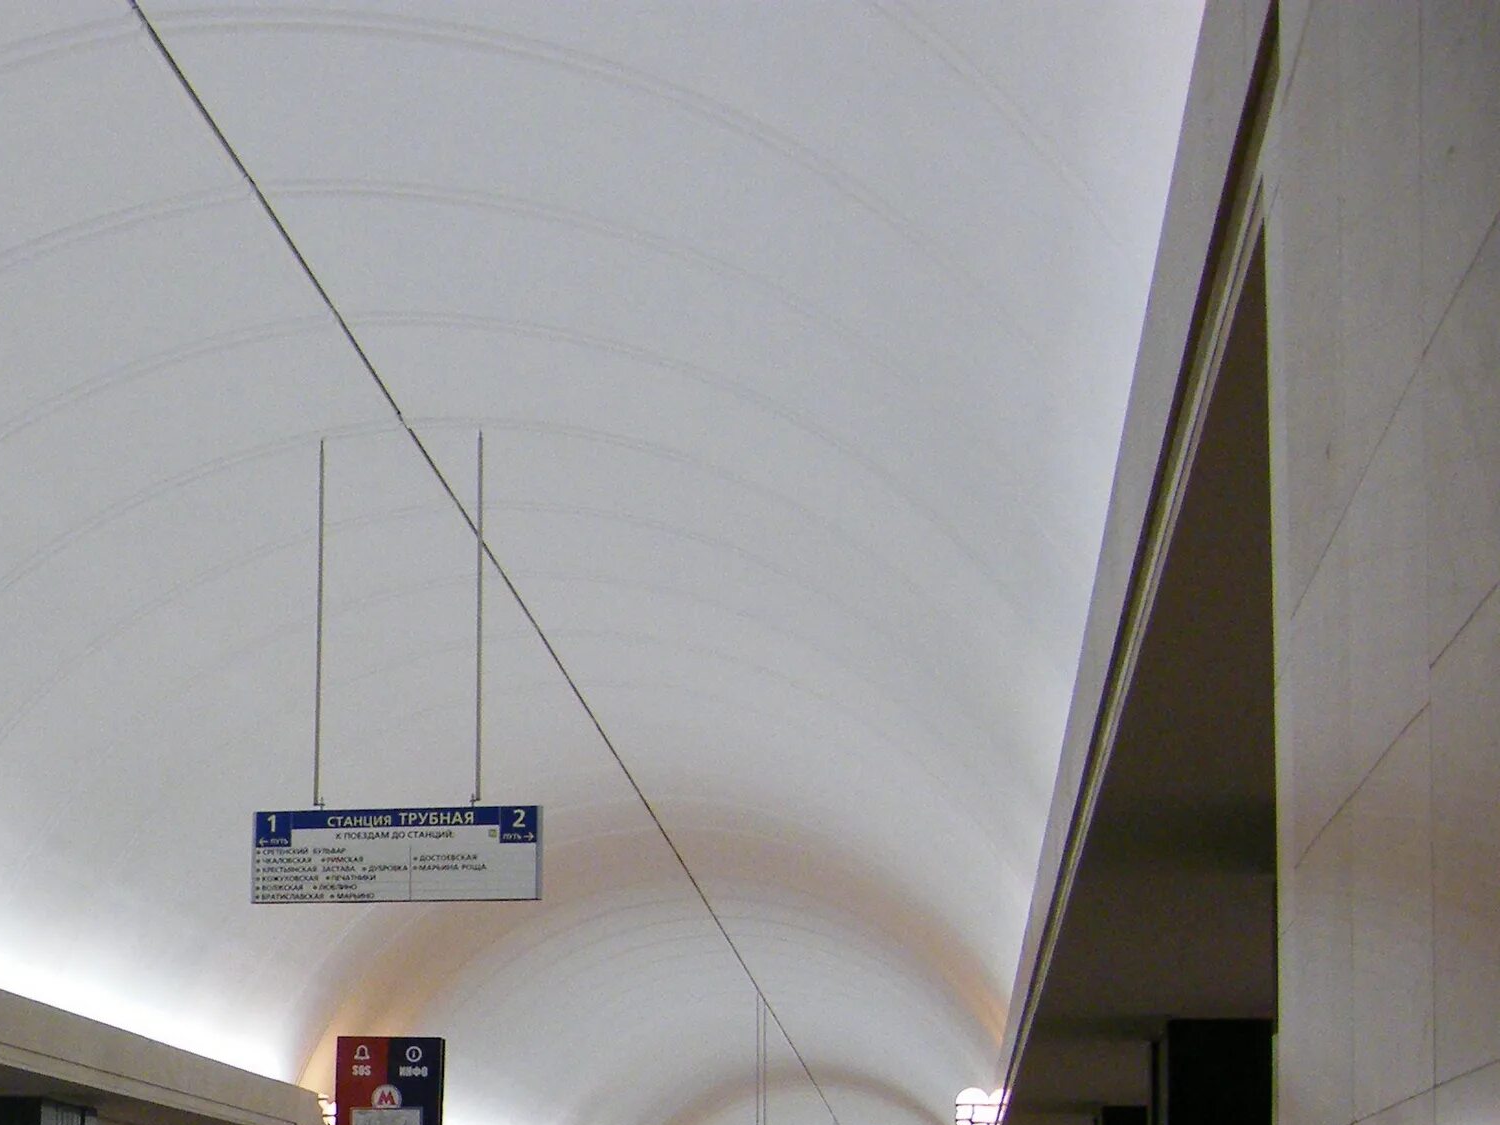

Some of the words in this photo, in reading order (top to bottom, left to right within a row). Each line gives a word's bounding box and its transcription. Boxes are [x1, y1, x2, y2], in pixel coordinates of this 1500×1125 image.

[267, 813, 277, 833] 1
[327, 814, 392, 828] СТАНЦИЯ
[399, 811, 474, 826] ТРУБНАЯ
[512, 808, 526, 828] 2
[344, 832, 389, 840] ПОЕЗДАМ
[391, 831, 406, 840] ДО
[351, 1064, 372, 1076] SOS
[399, 1065, 429, 1078] ИНФО
